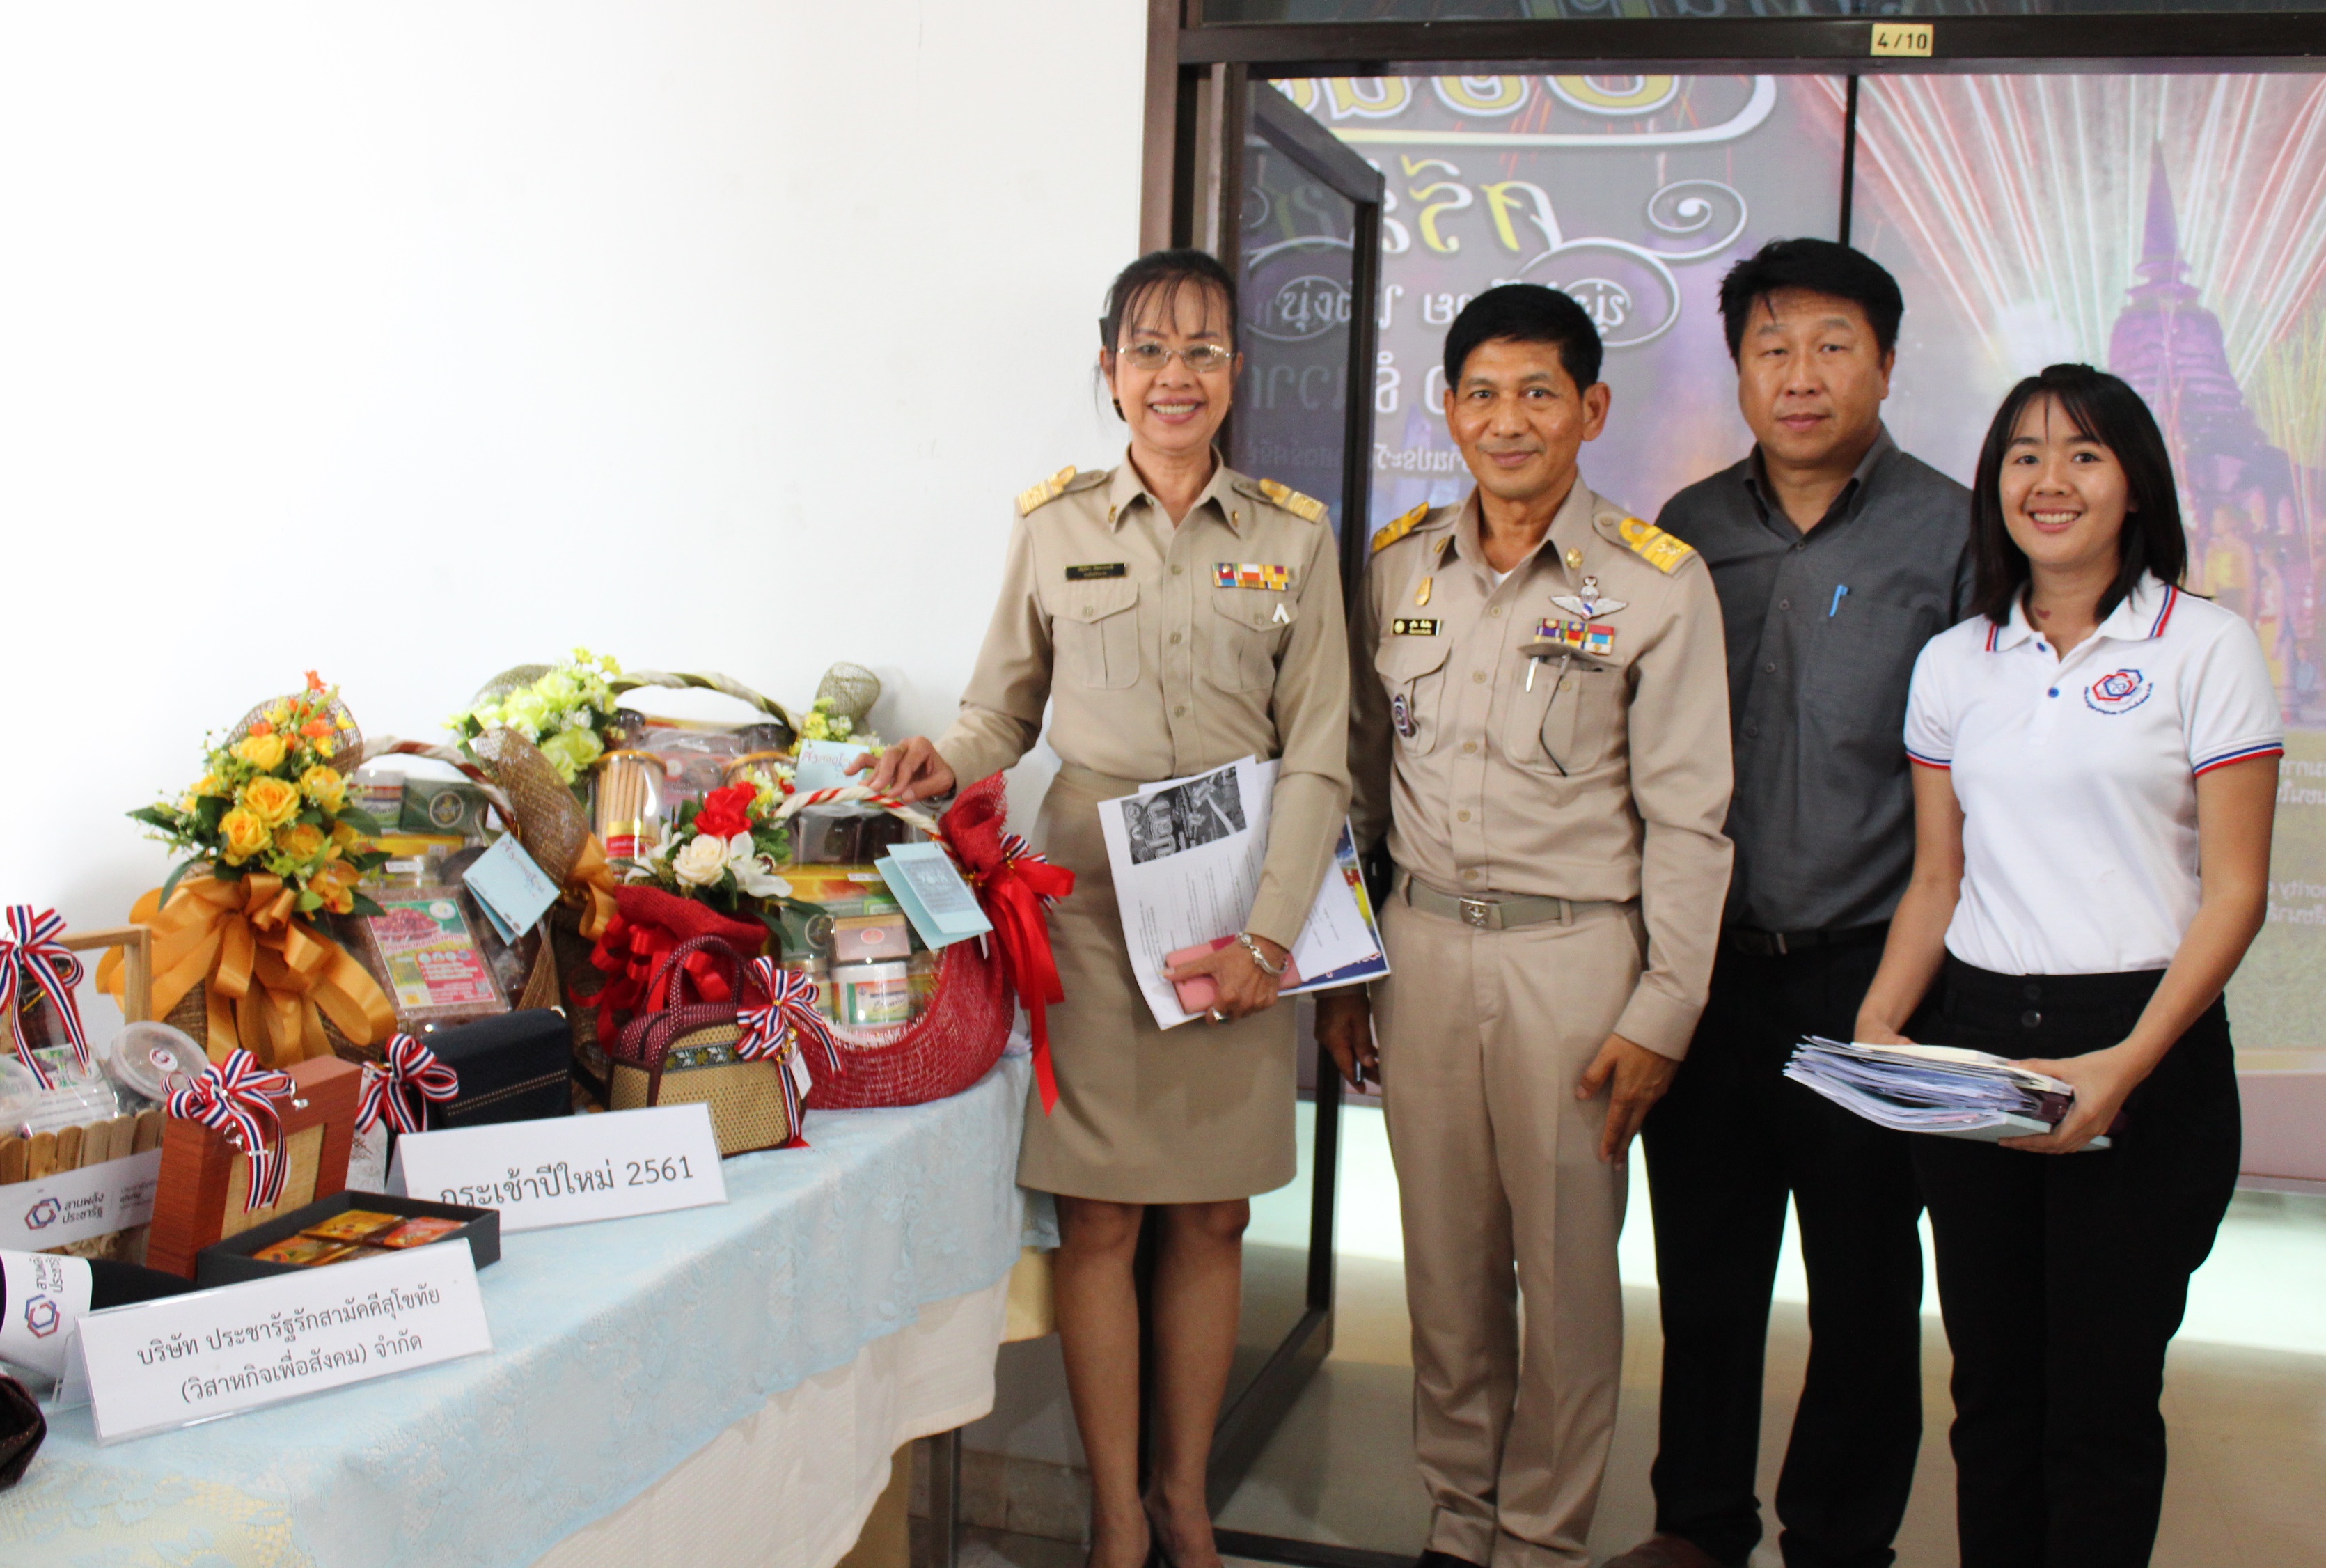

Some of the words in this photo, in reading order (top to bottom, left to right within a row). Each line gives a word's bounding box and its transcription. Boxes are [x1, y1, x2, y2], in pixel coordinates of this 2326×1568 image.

[1878, 32, 1927, 49] 4/10
[440, 1159, 615, 1207] กระเช้าปีใหม่
[627, 1155, 693, 1186] 2561
[137, 1332, 199, 1365] บริษัท
[206, 1283, 441, 1350] ประชารัฐรักสามัคคีสุโขทัย
[182, 1343, 367, 1403] (วิสาหกิจเพื่อสังคม)
[375, 1328, 423, 1358] จำกัด
